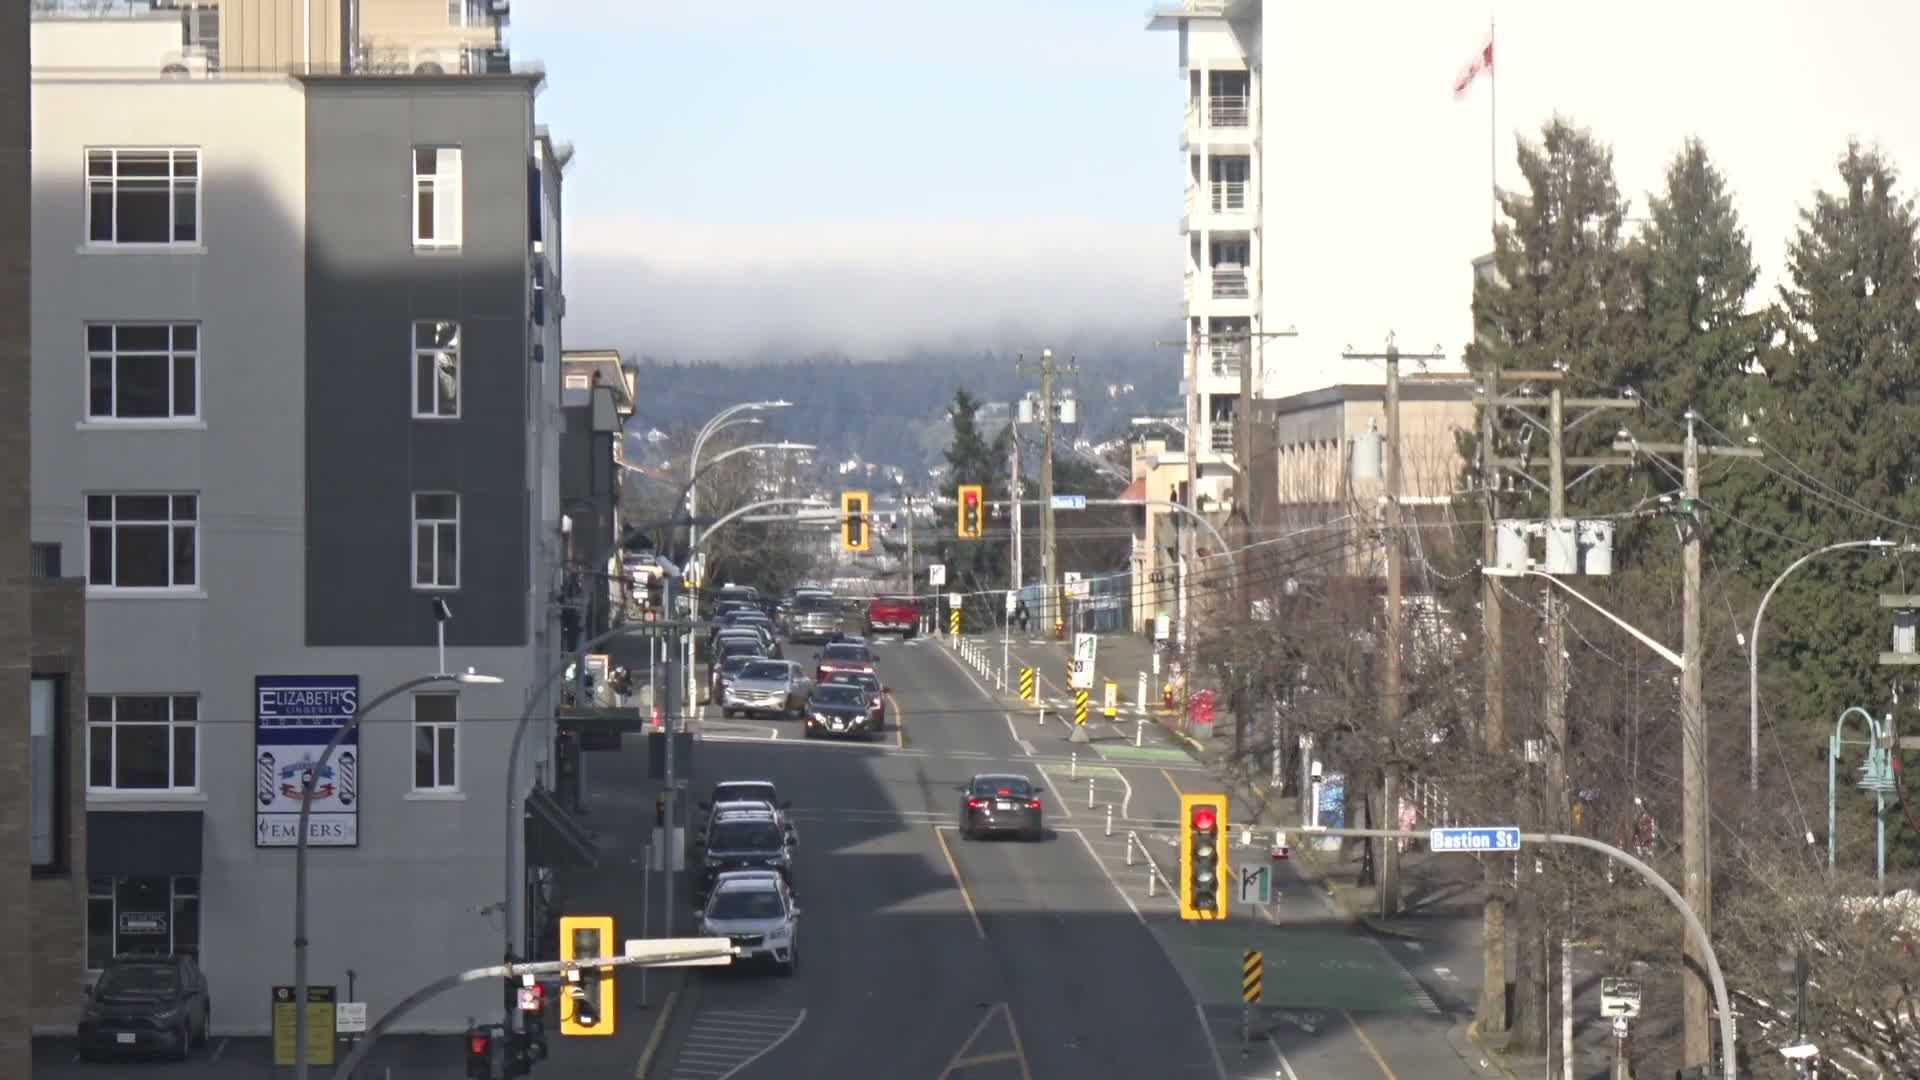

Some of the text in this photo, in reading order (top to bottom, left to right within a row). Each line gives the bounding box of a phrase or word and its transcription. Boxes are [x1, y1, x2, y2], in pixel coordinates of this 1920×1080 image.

[259, 690, 357, 715] ELIZABETH'S
[271, 824, 343, 838] EMERS
[1433, 830, 1518, 848] Bastion St.
